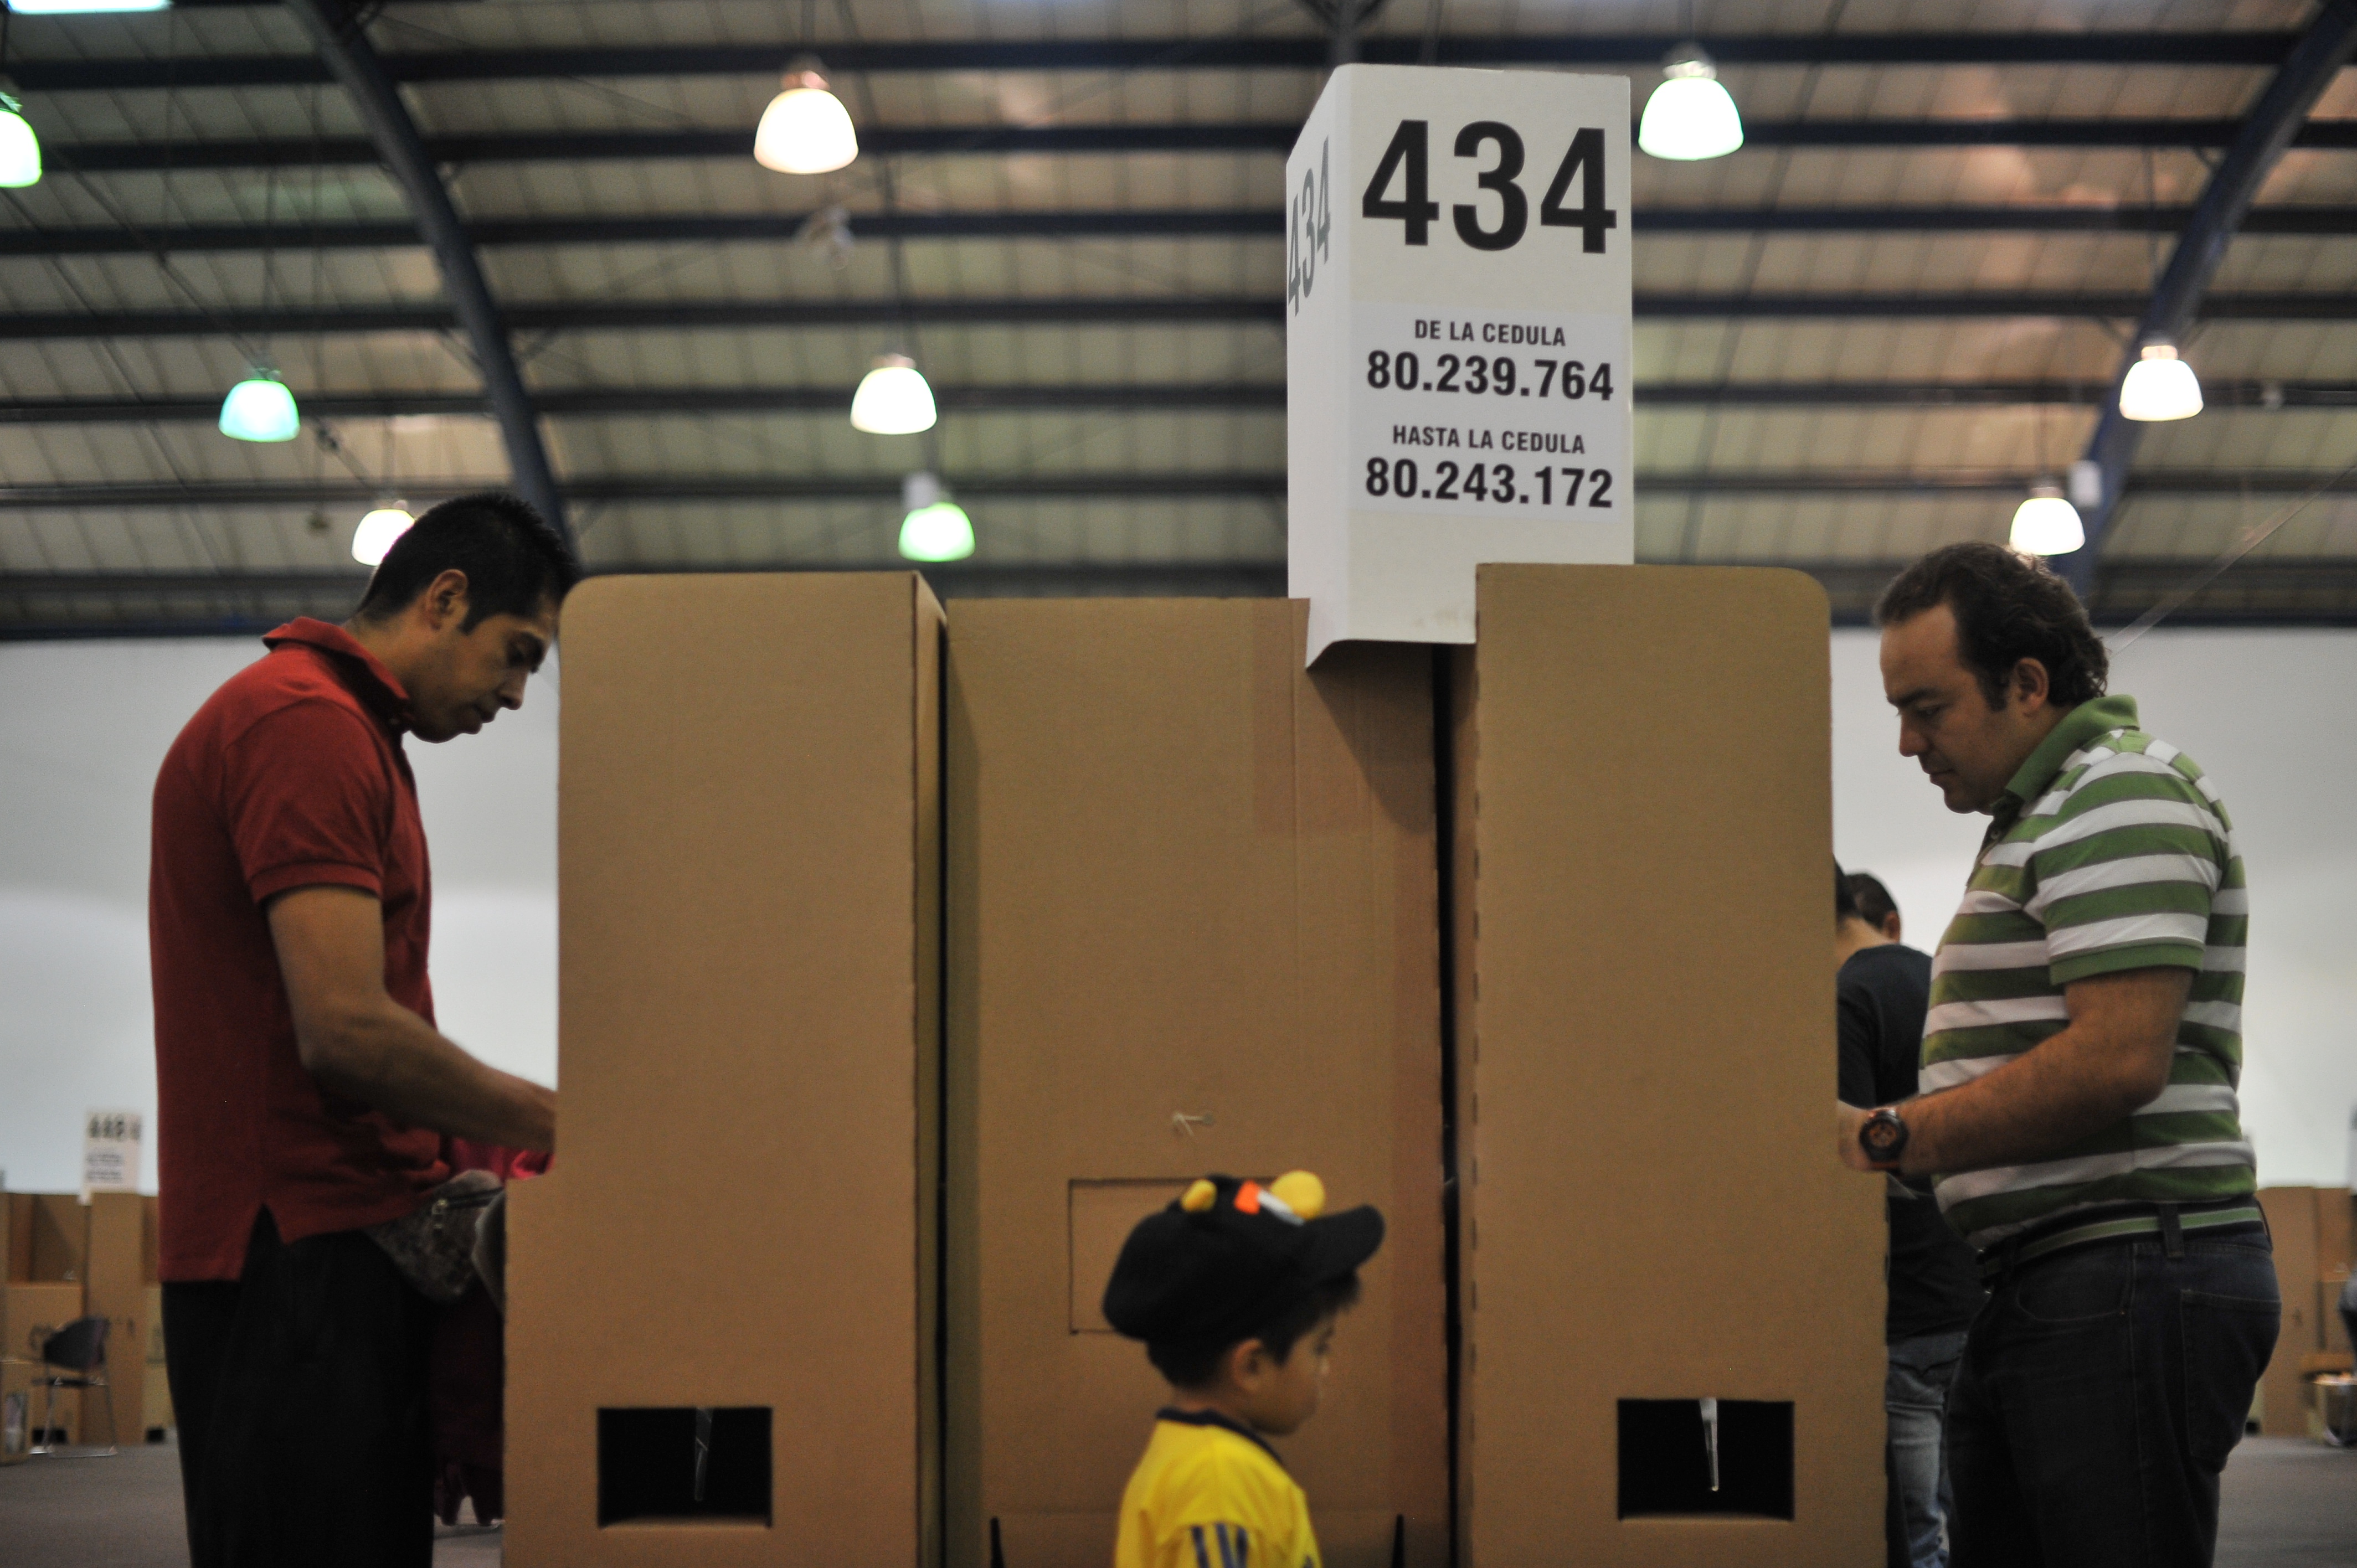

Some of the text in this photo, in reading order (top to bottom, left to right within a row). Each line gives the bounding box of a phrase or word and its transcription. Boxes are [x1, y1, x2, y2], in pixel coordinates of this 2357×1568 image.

[1362, 119, 1618, 255] 434
[1288, 135, 1330, 317] 434
[1414, 318, 1566, 347] DE LA CEDULA
[1366, 349, 1614, 401] 80.239.764
[1392, 424, 1586, 455] HASTA LA CEDULA
[1365, 456, 1613, 509] 80.243.172
